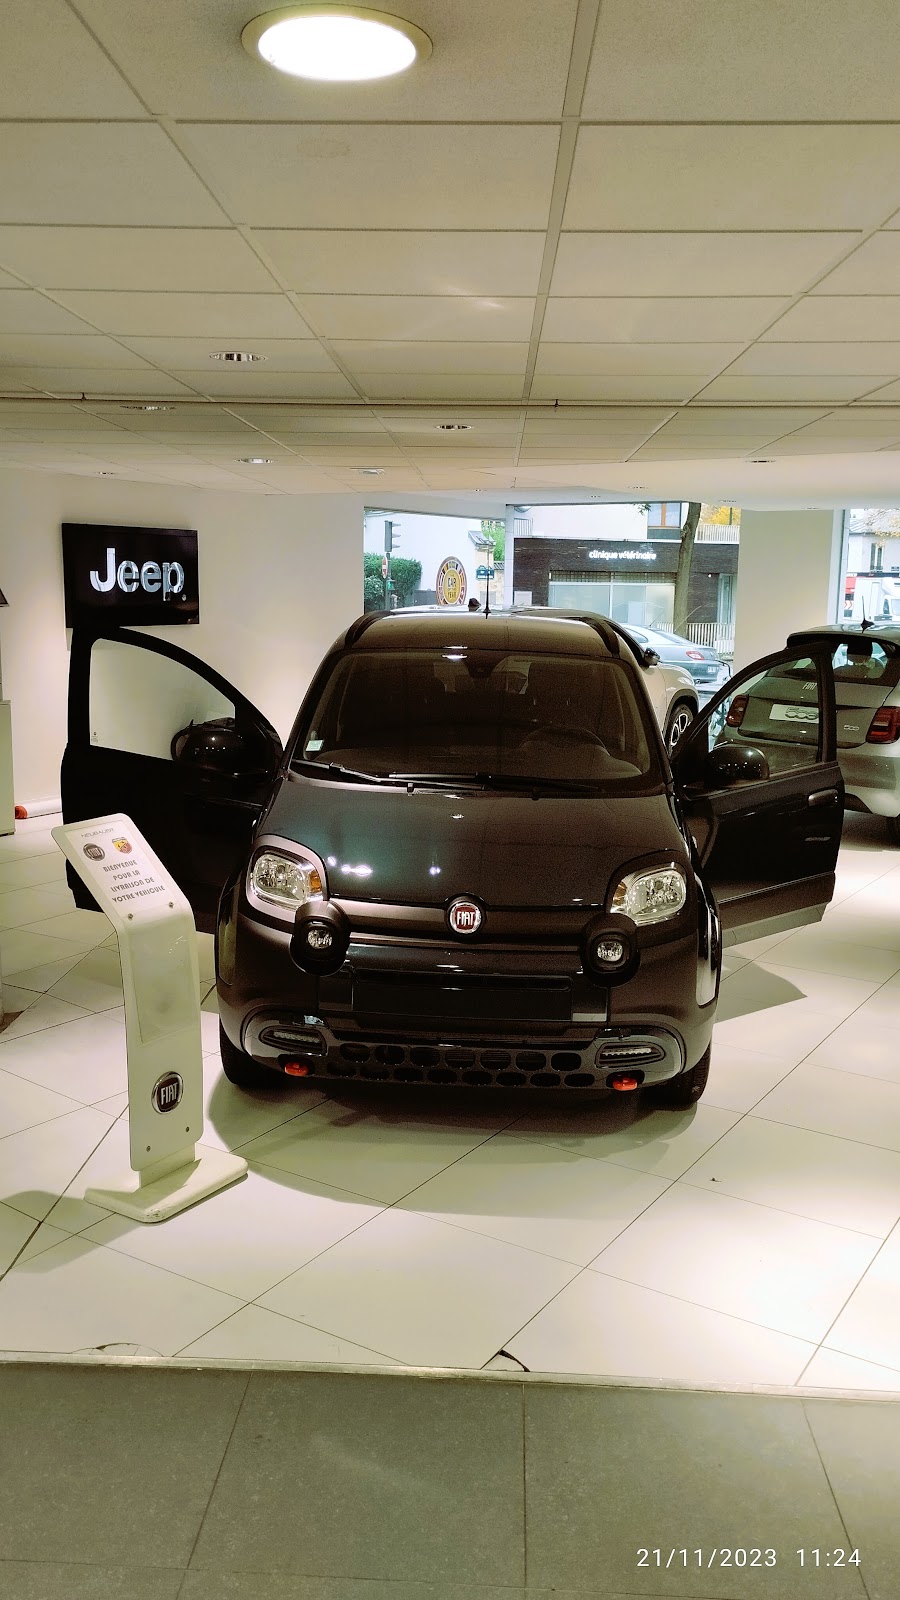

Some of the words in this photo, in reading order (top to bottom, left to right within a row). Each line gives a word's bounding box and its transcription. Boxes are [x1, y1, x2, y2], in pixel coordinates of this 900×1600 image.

[588, 550, 618, 560] clinique
[89, 547, 185, 602] Jeep
[448, 578, 456, 587] CAR
[102, 860, 137, 872] BIENVENUE
[112, 871, 132, 880] POUR
[110, 879, 144, 892] LIVRAISON
[112, 893, 135, 903] VOTRE
[135, 885, 165, 897] VEHICULE
[456, 912, 475, 926] FIAT
[160, 1082, 178, 1105] FIAT
